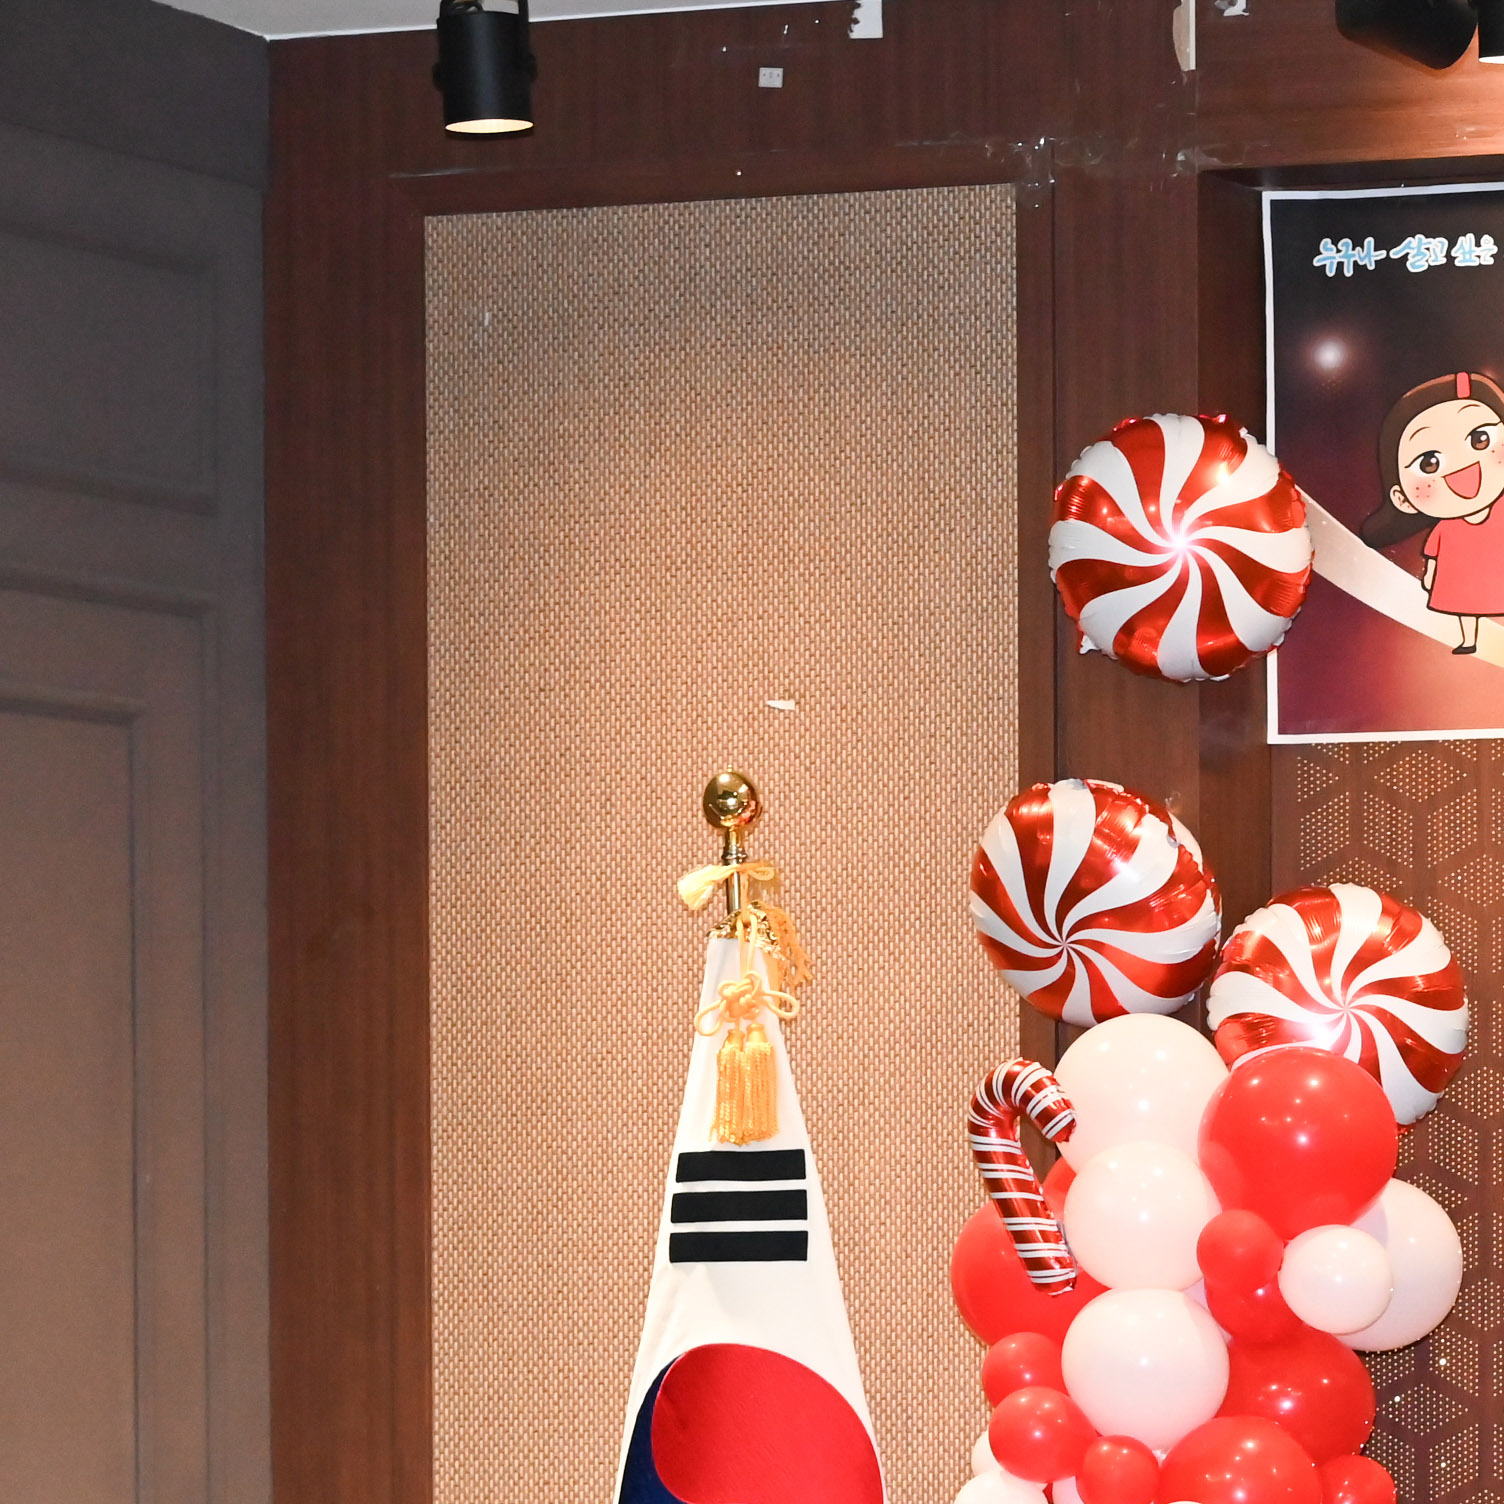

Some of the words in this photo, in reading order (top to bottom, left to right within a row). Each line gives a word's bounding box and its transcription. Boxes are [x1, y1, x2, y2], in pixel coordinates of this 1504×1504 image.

[1313, 237, 1386, 278] 누구나
[1390, 234, 1448, 272] 살고
[1451, 233, 1498, 267] 싶은
